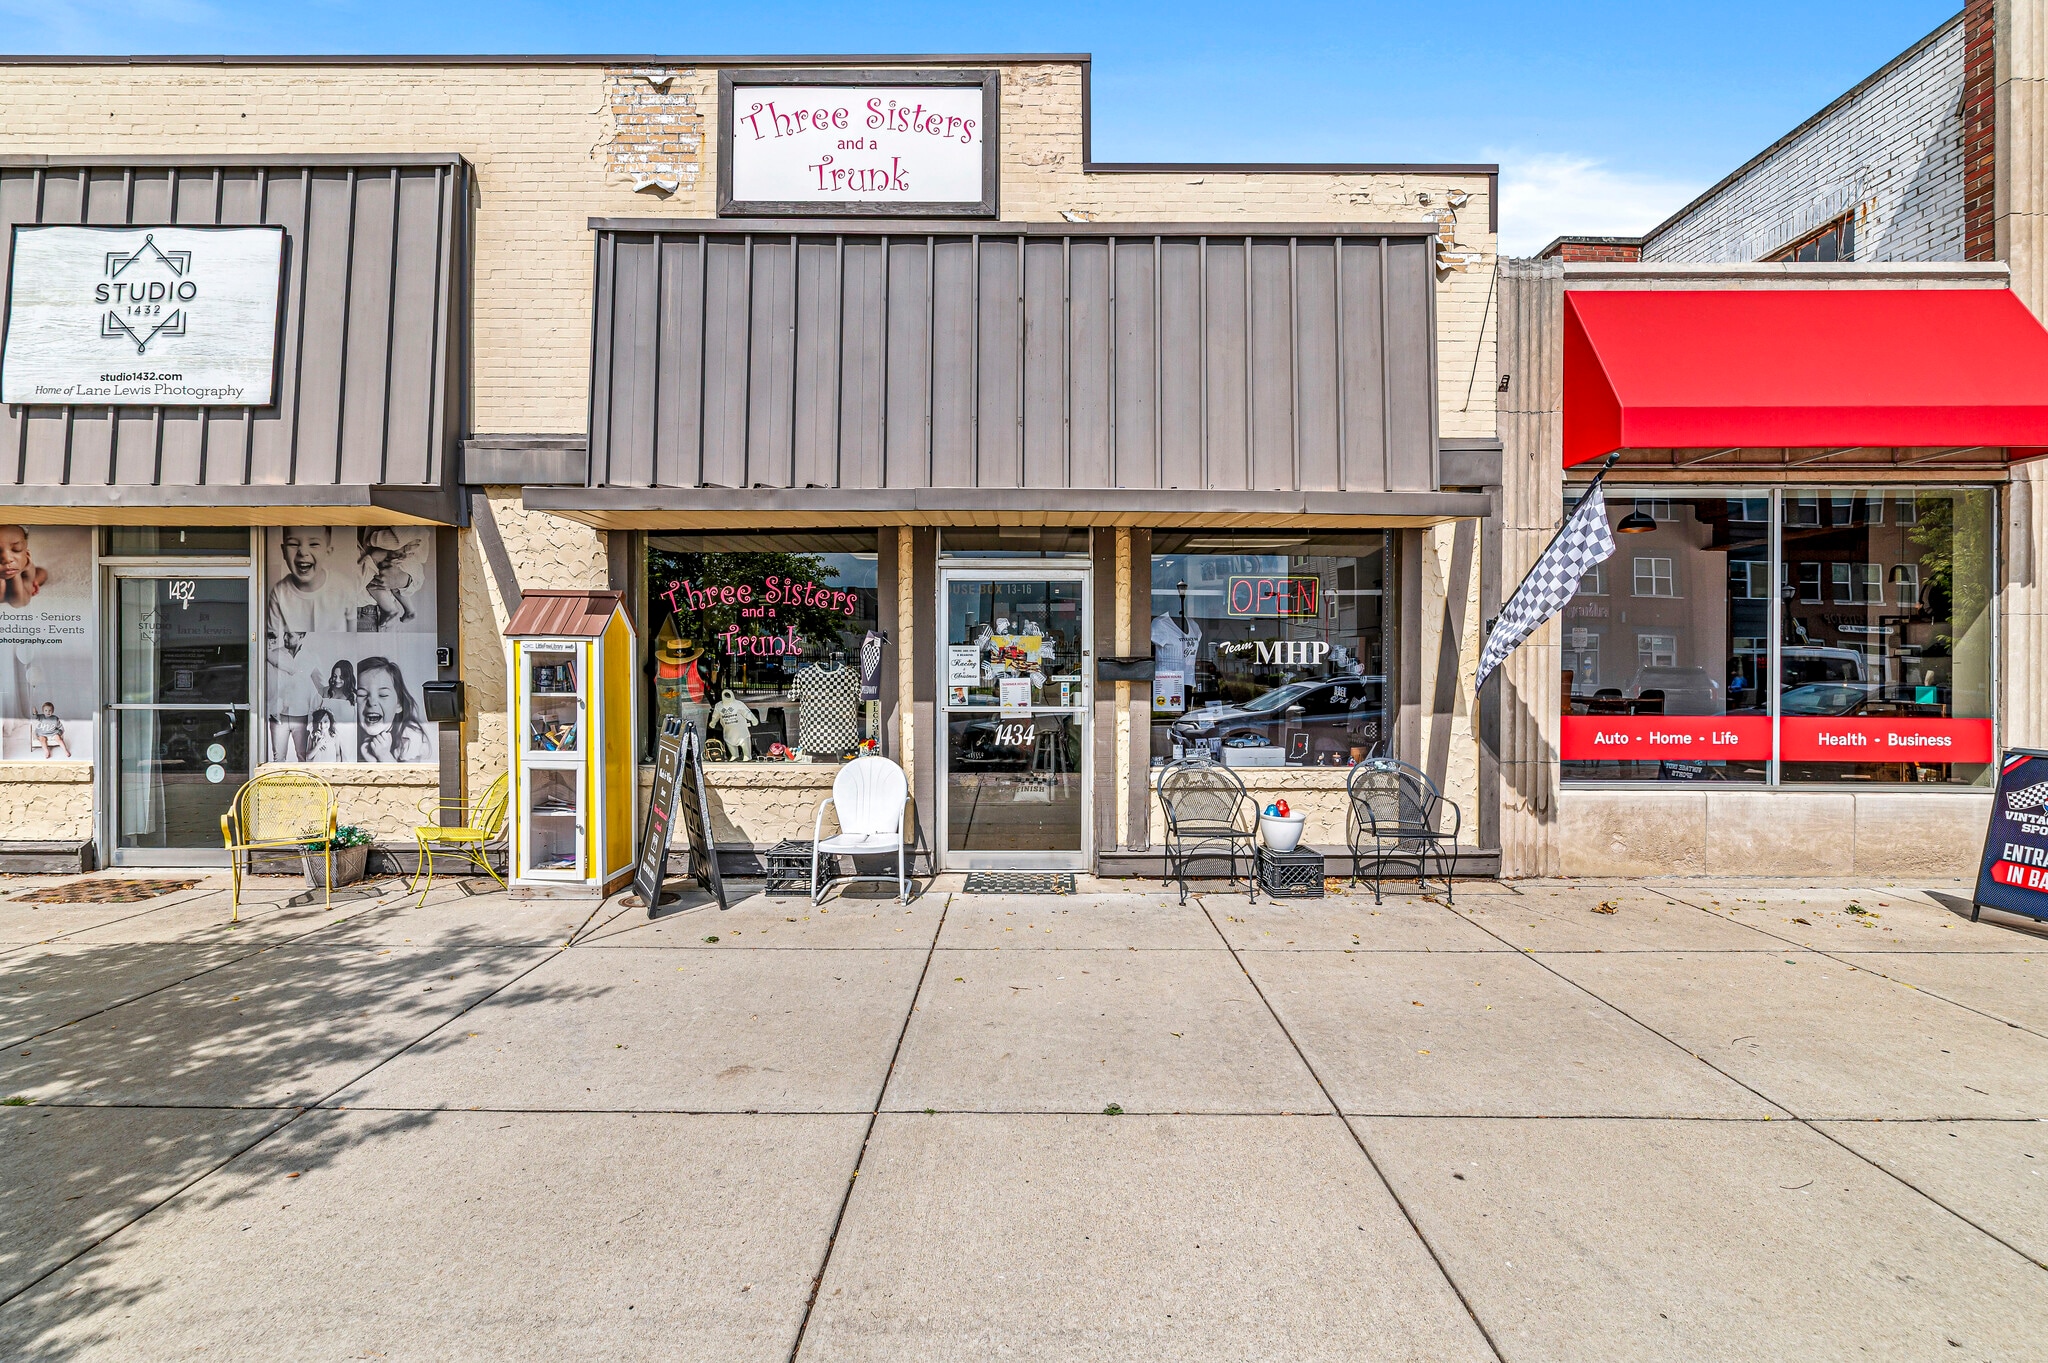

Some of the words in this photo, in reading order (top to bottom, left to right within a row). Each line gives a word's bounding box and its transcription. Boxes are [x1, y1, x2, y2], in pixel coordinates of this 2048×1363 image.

[740, 101, 849, 141] Three
[866, 97, 976, 144] Sisters
[837, 137, 864, 150] and
[869, 140, 877, 150] a
[808, 154, 909, 192] Trunk
[95, 280, 197, 303] STUDIO
[127, 305, 161, 316] 1432
[100, 372, 183, 383] studio1432.com
[35, 385, 62, 395] Home
[63, 385, 75, 396] of
[76, 384, 111, 396] Lane
[114, 384, 151, 396] Lewis
[153, 384, 244, 400] Photography
[169, 580, 196, 600] 1432
[660, 579, 751, 614] Three
[765, 575, 858, 616] Sisters
[980, 584, 1003, 595] BOX
[1007, 584, 1032, 595] 13-16
[1232, 579, 1316, 613] OPEN
[0, 611, 34, 621] borns
[41, 612, 82, 621] Seniors
[742, 606, 764, 618] and
[768, 609, 776, 618] a
[49, 624, 85, 634] Events
[138, 622, 172, 630] STUDIO
[717, 624, 803, 657] Trunk
[1220, 641, 1254, 655] Team
[1253, 640, 1330, 665] MHP
[951, 659, 977, 669] Racing
[995, 724, 1035, 746] 1434
[1594, 731, 1628, 746] Auto
[1649, 731, 1692, 746] Home
[1712, 731, 1739, 746] Life
[1818, 732, 1867, 746] Health
[1887, 732, 1952, 748] Business
[2004, 810, 2048, 826] VINTA
[2006, 865, 2024, 885] IN
